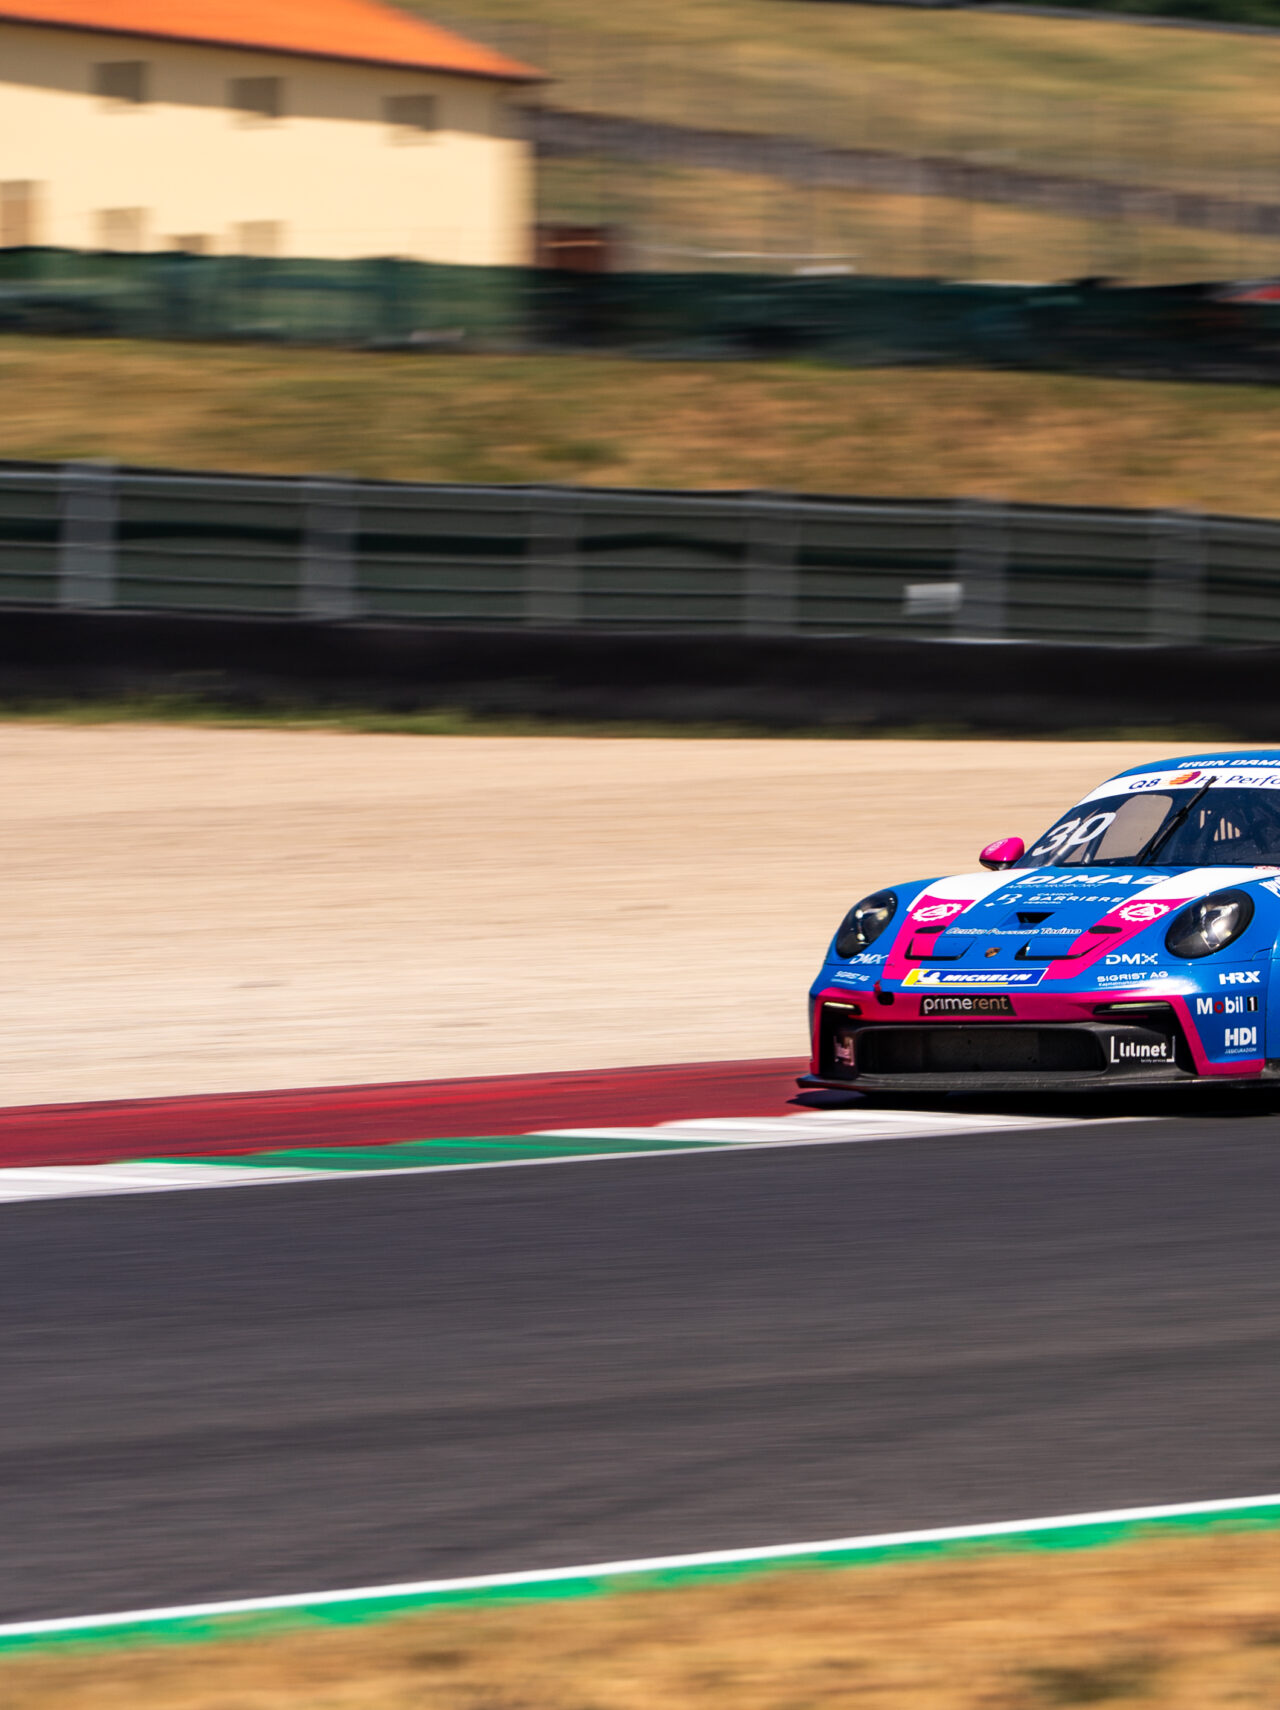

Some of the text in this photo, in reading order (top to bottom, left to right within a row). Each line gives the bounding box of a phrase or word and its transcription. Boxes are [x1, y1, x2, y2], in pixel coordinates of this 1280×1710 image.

[1177, 759, 1225, 768] IRON
[1128, 777, 1162, 790] Q8
[1031, 812, 1117, 856] 30
[1016, 874, 1170, 885] DIMAB
[1105, 953, 1159, 965] DMX
[944, 973, 1033, 982] MICHELIN
[1097, 970, 1169, 982] SIGRIST AG
[1219, 970, 1261, 985] HRX
[923, 995, 1009, 1014] primerent
[1196, 996, 1257, 1015] Mobil 1
[1224, 1026, 1257, 1047] HDI
